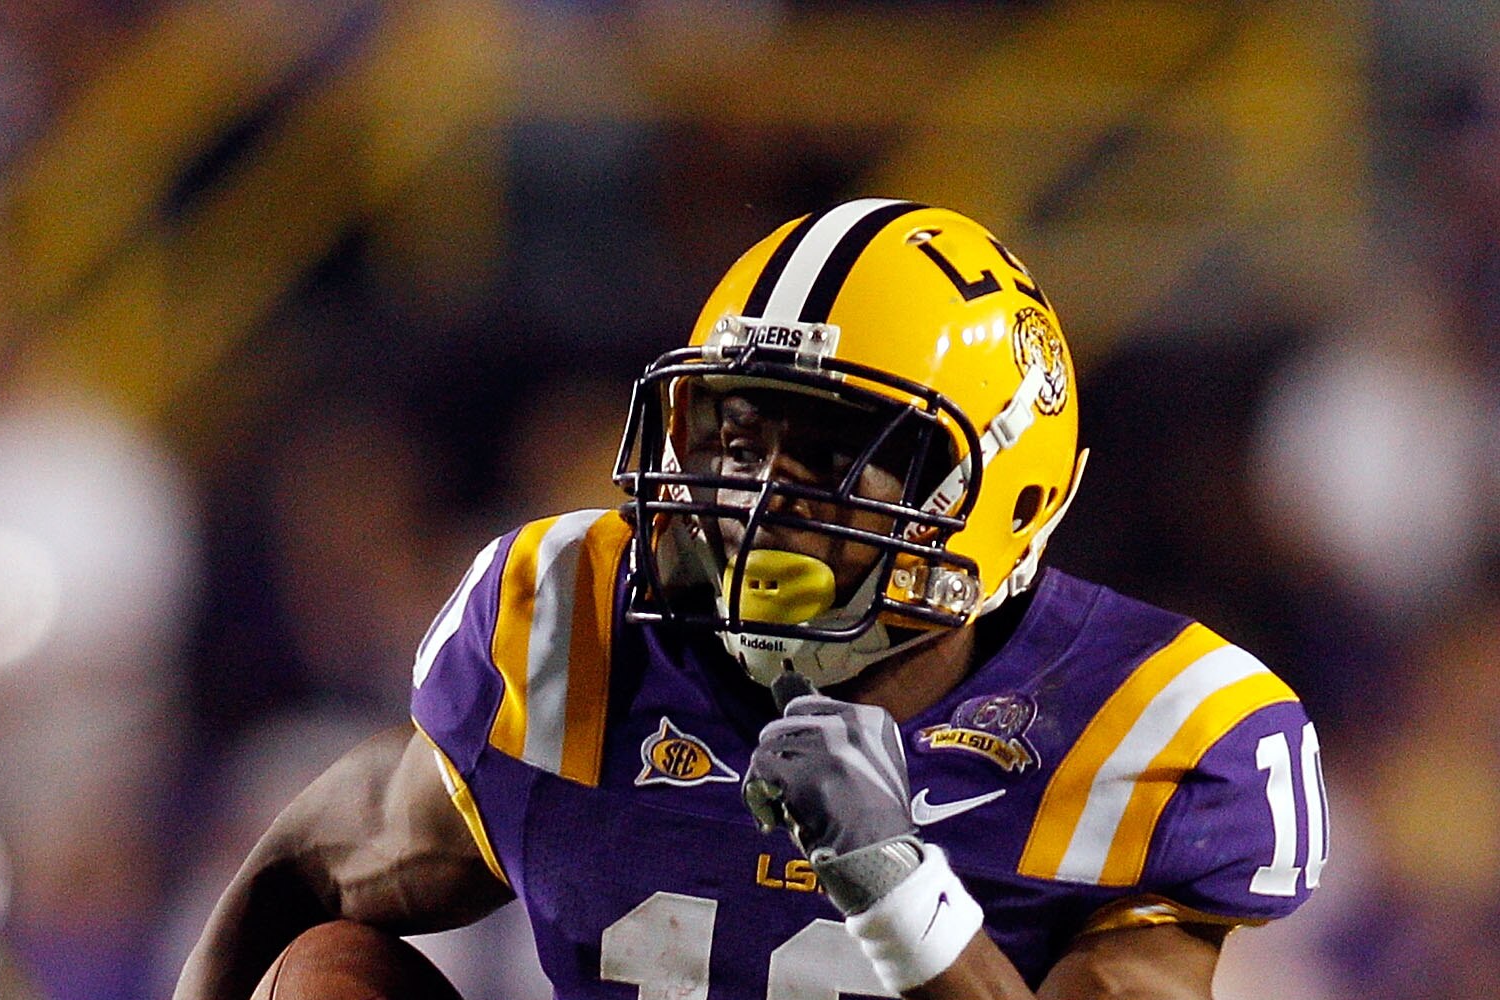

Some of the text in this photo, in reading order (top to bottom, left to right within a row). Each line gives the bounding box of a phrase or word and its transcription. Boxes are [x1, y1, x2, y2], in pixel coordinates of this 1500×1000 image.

[957, 732, 994, 751] LSU
[662, 742, 698, 776] SEC
[756, 853, 824, 893] LS
